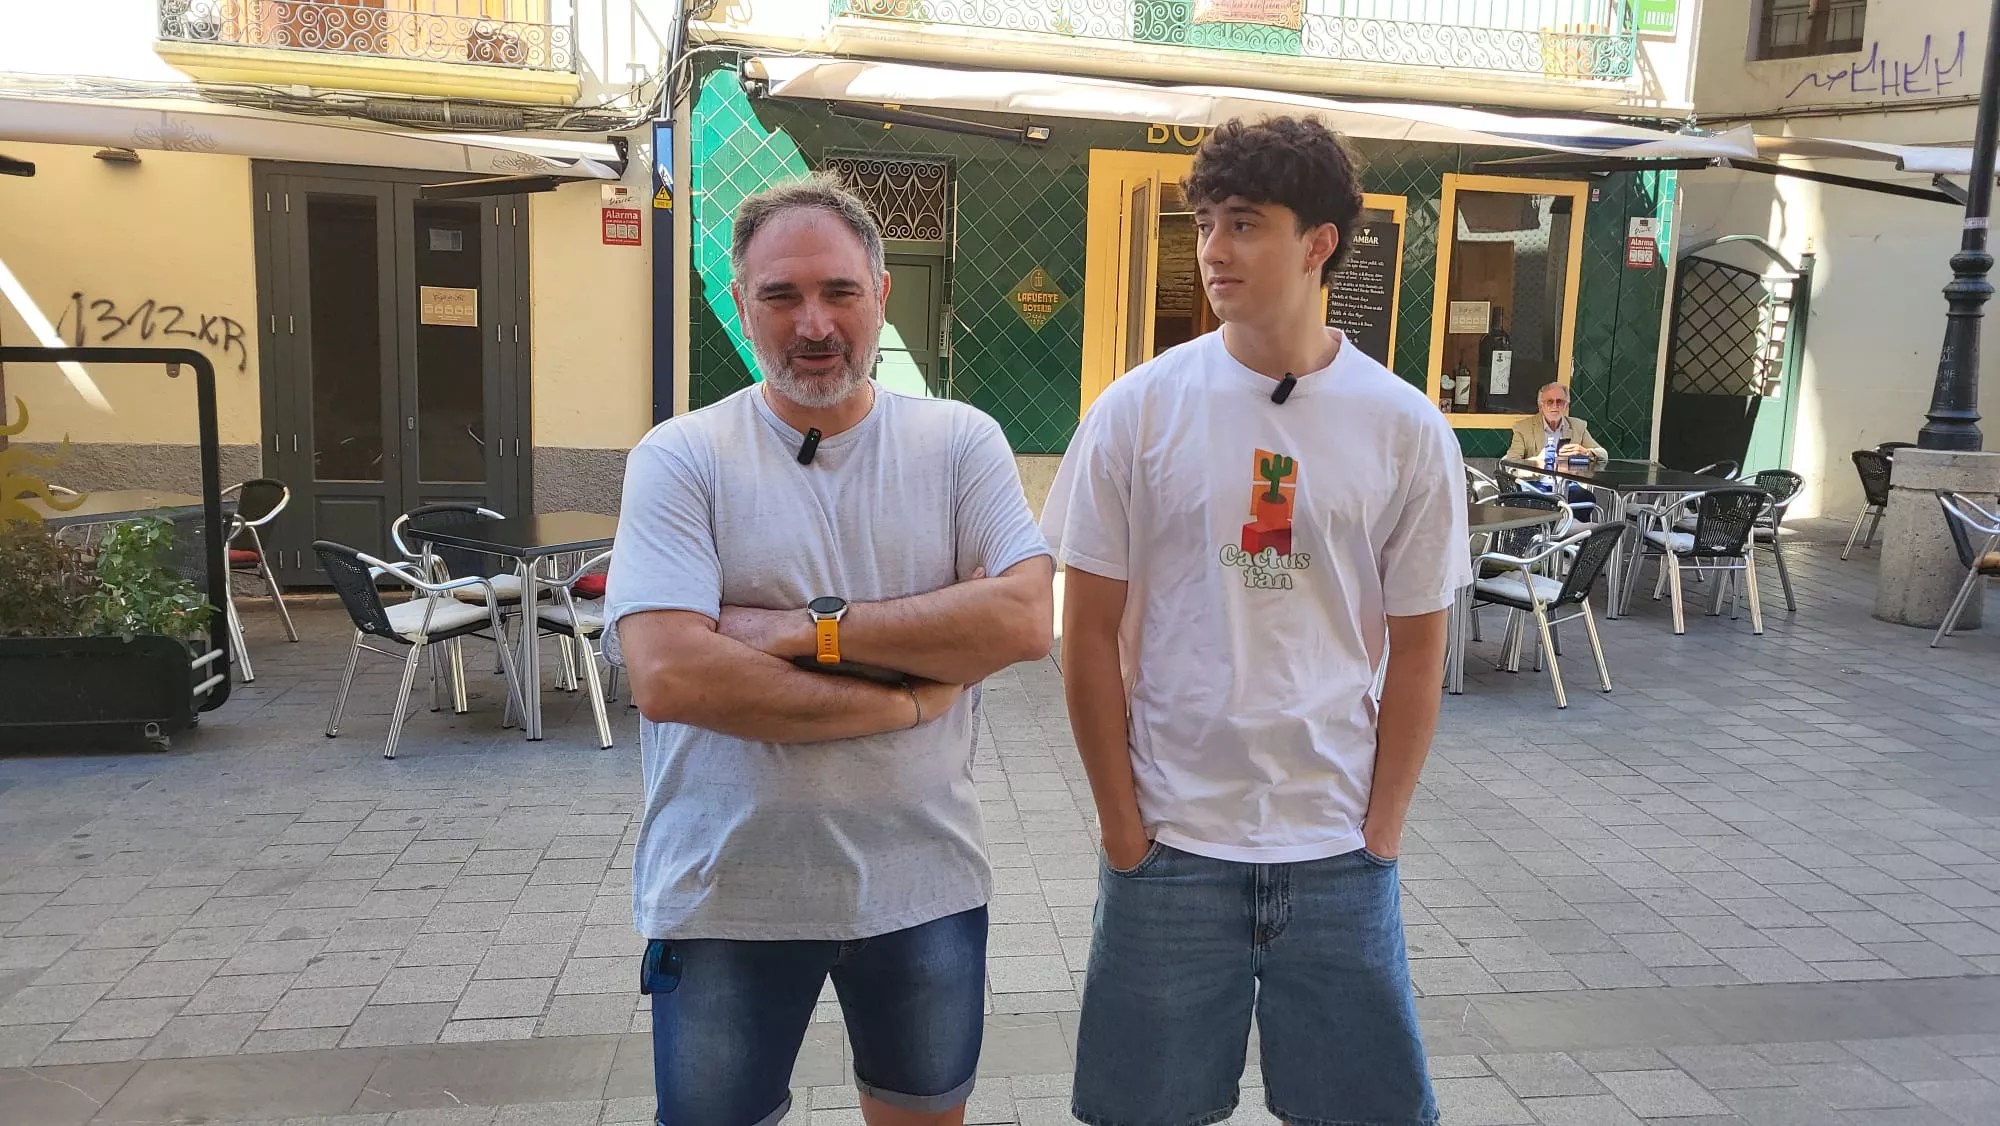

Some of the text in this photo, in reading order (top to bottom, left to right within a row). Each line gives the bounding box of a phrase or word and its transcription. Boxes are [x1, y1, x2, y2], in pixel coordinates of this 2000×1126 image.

[606, 210, 638, 220] Alarma
[1353, 235, 1379, 245] AMBAR
[1630, 238, 1654, 247] Alarma
[1017, 292, 1059, 302] LAFUENTE
[1220, 543, 1311, 569] Cactus
[1243, 566, 1293, 590] fan
